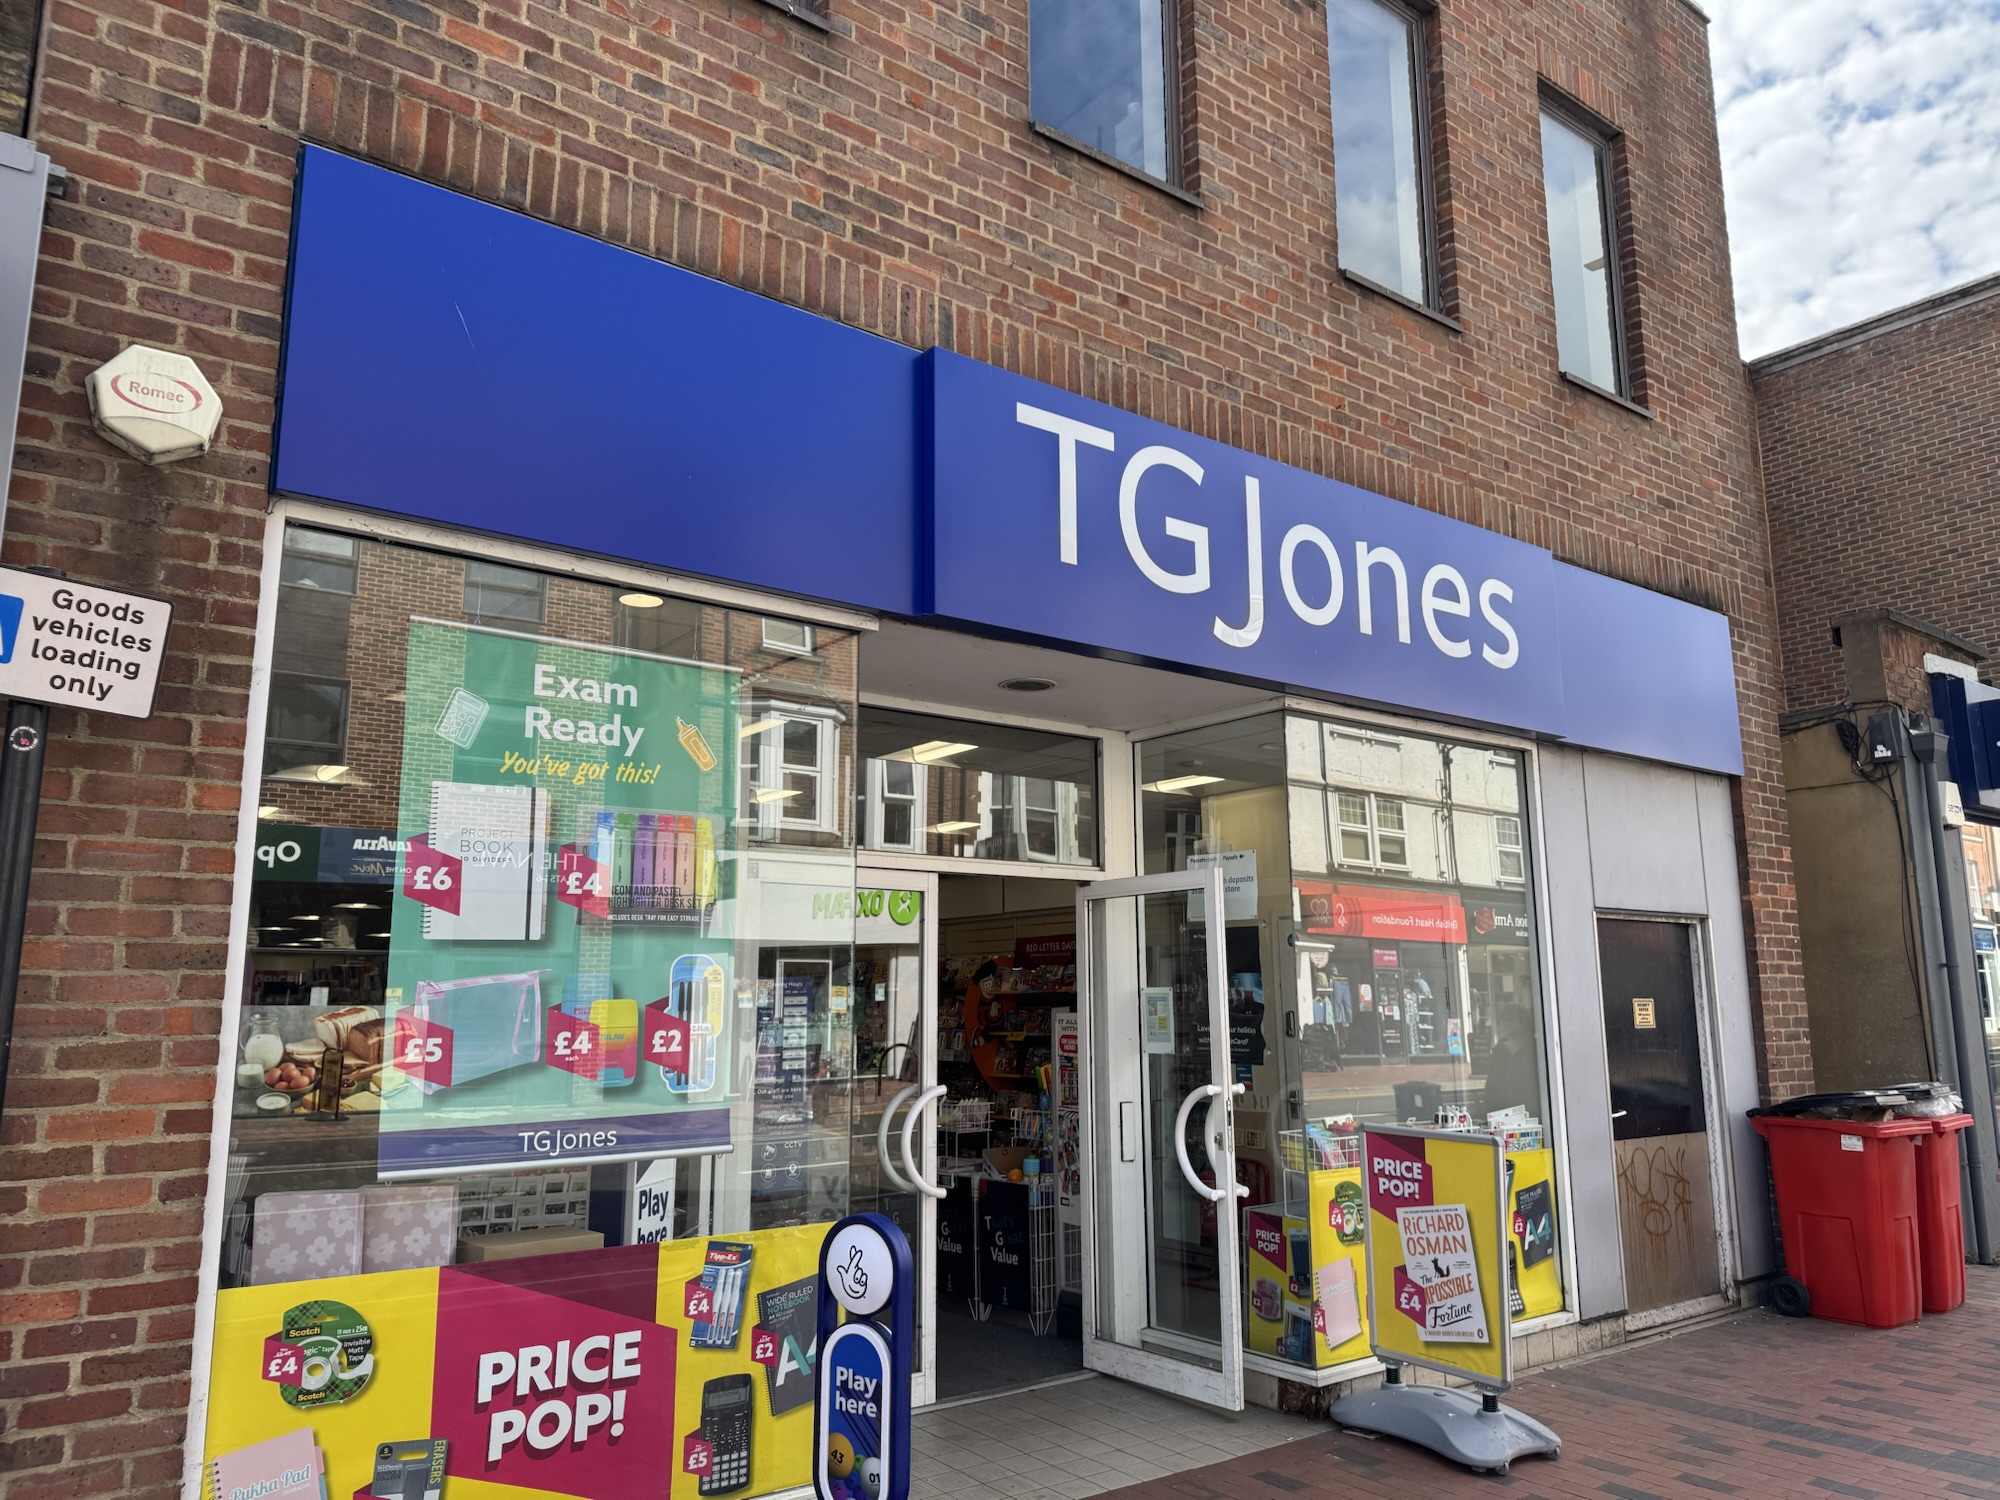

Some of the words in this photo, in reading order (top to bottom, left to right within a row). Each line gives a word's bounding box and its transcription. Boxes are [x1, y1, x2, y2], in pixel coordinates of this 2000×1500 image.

[129, 381, 184, 403] Romec
[1016, 402, 1520, 669] TGJones
[52, 589, 145, 624] Goods
[32, 615, 152, 652] vehicles
[31, 638, 141, 680] loading
[49, 674, 113, 701] only
[534, 664, 638, 707] Exam
[524, 706, 645, 757] Ready
[500, 751, 570, 777] You've
[573, 761, 609, 786] got
[615, 761, 662, 785] this!
[461, 828, 514, 838] PROJECT
[460, 839, 514, 853] BOOK
[413, 866, 452, 890] £6
[566, 872, 602, 895] £4
[1228, 875, 1254, 885] deposits
[634, 886, 652, 897] AND
[654, 886, 684, 897] PASTEL
[664, 898, 685, 909] DESK
[687, 899, 702, 909] SET
[1026, 943, 1039, 952] RED
[1040, 942, 1061, 952] LETTER
[404, 1037, 443, 1063] £5
[554, 1030, 592, 1055] £4
[652, 1029, 682, 1053] £2
[518, 1129, 617, 1156] TGJones
[784, 1141, 802, 1149] CCTV
[1373, 1157, 1423, 1180] PRICE
[1378, 1177, 1419, 1199] POP!
[638, 1187, 669, 1222] Play
[1331, 1213, 1342, 1225] £4
[1514, 1222, 1524, 1233] £2
[638, 1224, 667, 1244] here
[995, 1230, 1024, 1246] Great
[1256, 1229, 1280, 1243] PRICE
[1524, 1211, 1552, 1251] A4
[937, 1236, 962, 1254] Value
[1257, 1240, 1279, 1254] POP!
[1406, 1235, 1467, 1257] OSMAN
[709, 1252, 738, 1260] Tipp-Ex
[990, 1246, 1019, 1265] Value
[1291, 1284, 1298, 1293] £2
[1419, 1274, 1432, 1285] The
[688, 1298, 709, 1315] £4
[766, 1293, 787, 1307] WIDE
[788, 1286, 813, 1299] RULED
[767, 1295, 811, 1315] NOTEBOOK
[1253, 1297, 1261, 1306] £2
[1400, 1292, 1421, 1311] £4
[1315, 1317, 1324, 1328] £4
[1428, 1302, 1472, 1328] Fortune
[289, 1327, 320, 1337] Scotch
[355, 1325, 369, 1333] 25m
[344, 1338, 371, 1348] Invisible
[756, 1343, 774, 1359] £2
[268, 1356, 298, 1378] £4
[348, 1354, 365, 1362] Tape
[477, 1330, 642, 1404] PRICE
[836, 1366, 877, 1398] Play
[297, 1392, 326, 1402] Scotch
[835, 1391, 877, 1418] here
[488, 1389, 627, 1462] POP!
[430, 1439, 446, 1484] ERASERS
[688, 1457, 708, 1470] £5
[831, 1449, 845, 1464] 43
[230, 1481, 279, 1500] Pukka
[281, 1464, 312, 1488] Pad
